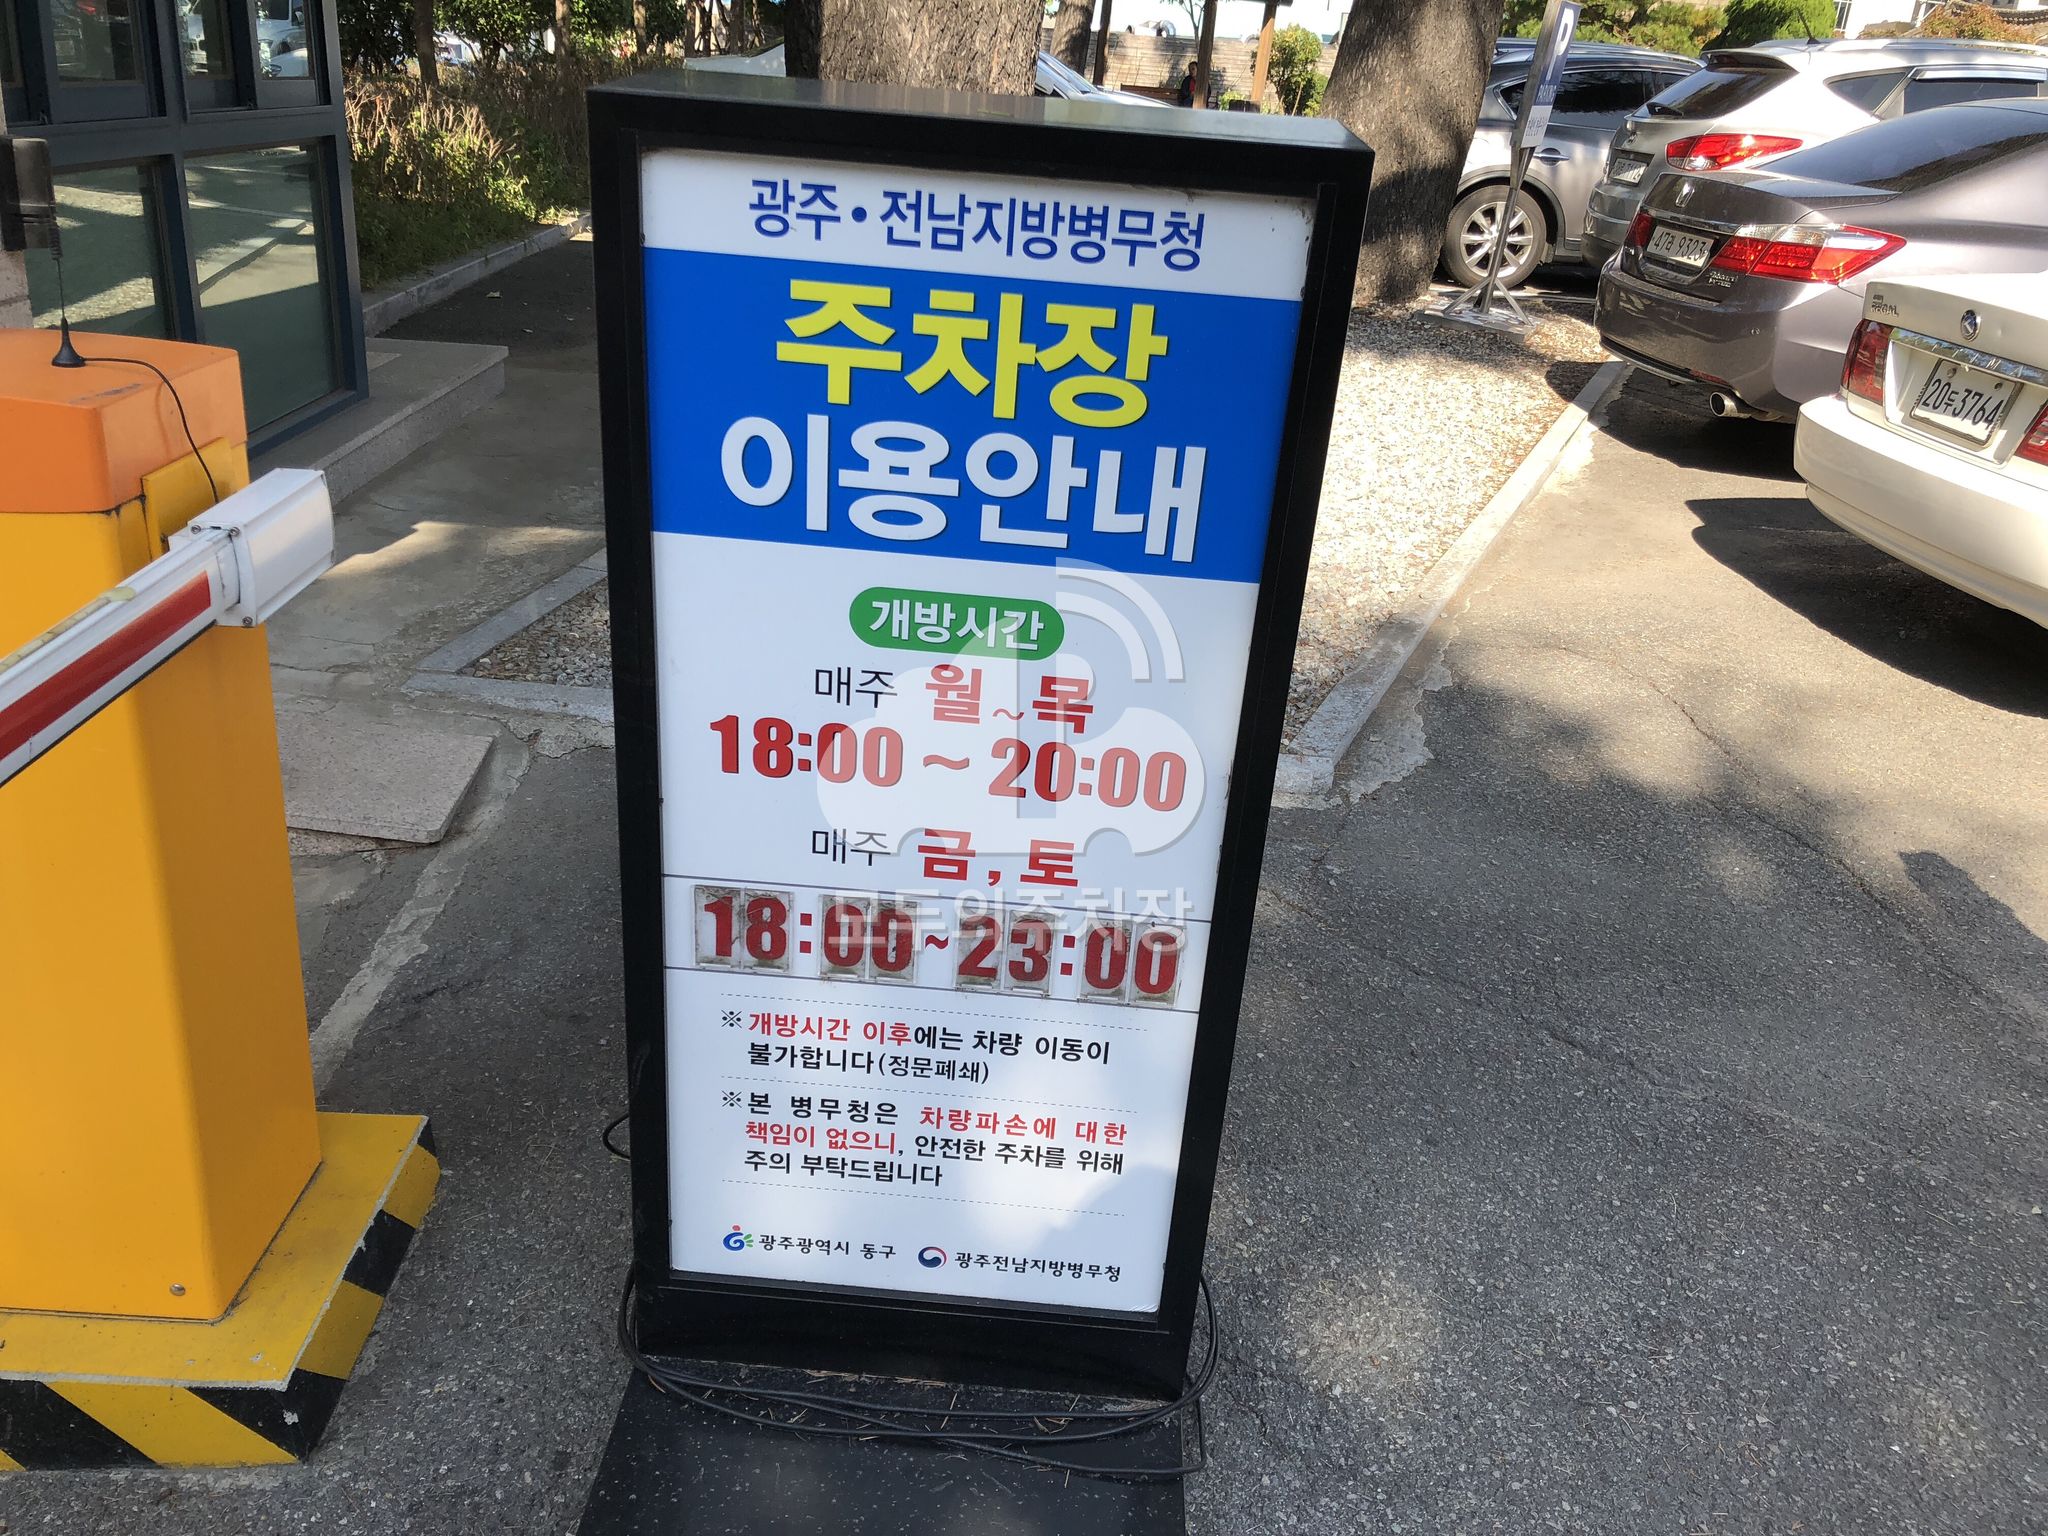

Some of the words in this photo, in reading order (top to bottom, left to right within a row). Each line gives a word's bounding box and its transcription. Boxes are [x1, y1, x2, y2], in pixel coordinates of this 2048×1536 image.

[1545, 8, 1574, 84] P
[776, 278, 1168, 428] 주차장
[720, 413, 1207, 564] 이용안내
[868, 598, 1046, 652] 개방시간
[814, 665, 898, 710] 매주
[709, 714, 904, 788] 18:00
[988, 736, 1188, 812] 20:00
[811, 826, 892, 867] 매주
[748, 1012, 851, 1042] 개방시간
[863, 1021, 964, 1051] 이후에는
[972, 1030, 1023, 1056] 차량
[1035, 1036, 1110, 1065] 이동이
[748, 1092, 772, 1115] 본
[791, 1095, 898, 1125] 병무청은
[919, 1106, 1057, 1140] 차량파손에
[1075, 1120, 1127, 1146] 대한
[744, 1150, 791, 1174] 주의
[801, 1154, 943, 1187] 부탁드립니다
[745, 1121, 815, 1148] 책임이
[826, 1128, 904, 1157] 없으니,
[914, 1135, 986, 1162] 안전한
[995, 1142, 1066, 1170] 주차를
[1076, 1149, 1124, 1175] 위해
[758, 1234, 850, 1256] 광주광역시
[860, 1243, 897, 1260] 동구
[955, 1251, 1121, 1283] 광주전남지방병무청
